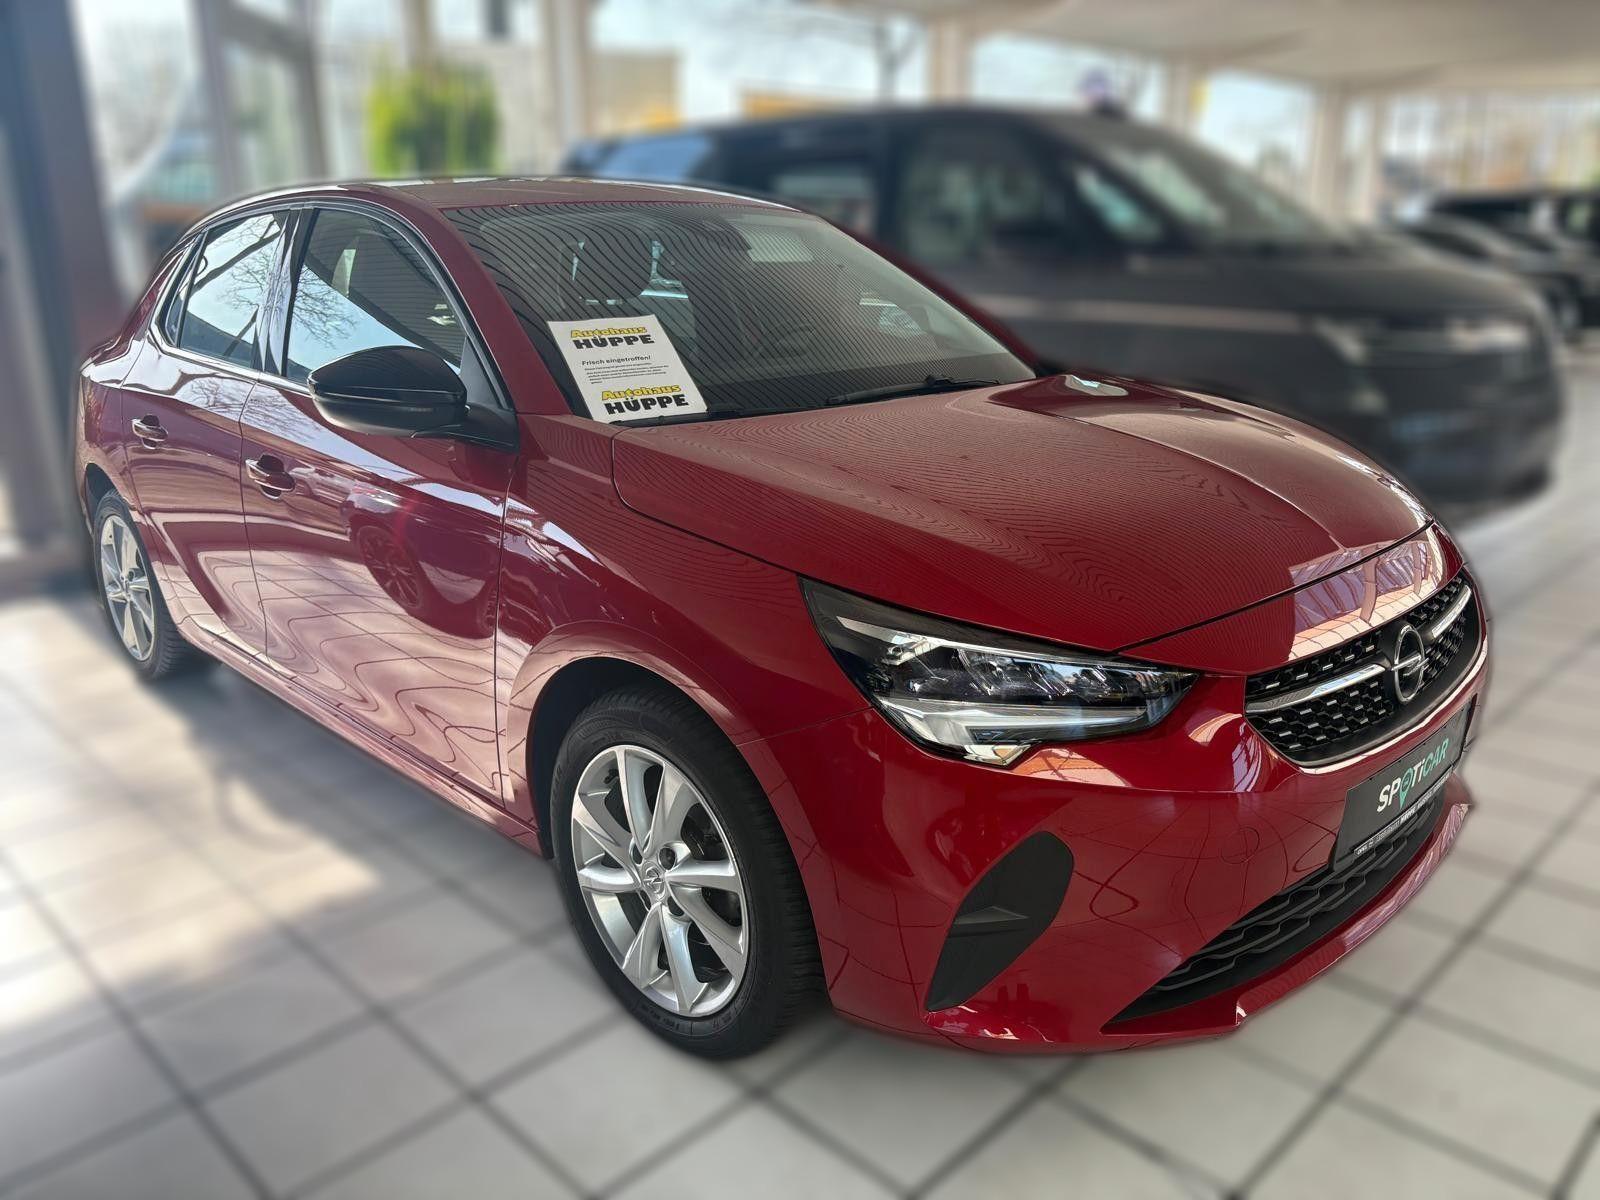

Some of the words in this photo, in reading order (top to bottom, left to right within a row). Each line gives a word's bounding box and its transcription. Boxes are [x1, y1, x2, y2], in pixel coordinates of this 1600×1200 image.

[570, 326, 648, 338] Autohaus
[572, 334, 655, 349] HÜPPE
[606, 355, 651, 364] eingetroffen!
[601, 384, 681, 401] Autohaus
[603, 393, 689, 415] HÜPPE
